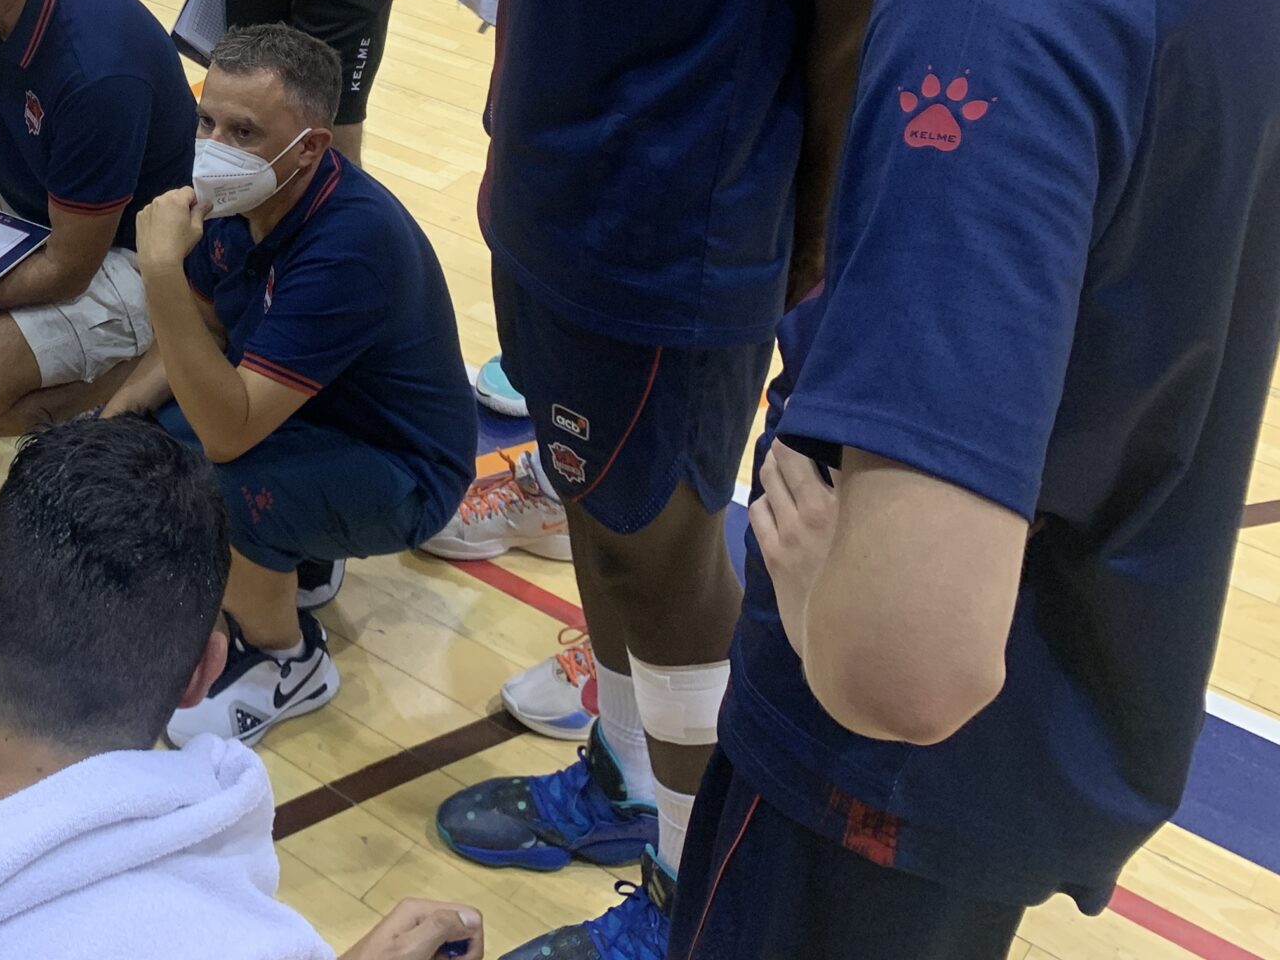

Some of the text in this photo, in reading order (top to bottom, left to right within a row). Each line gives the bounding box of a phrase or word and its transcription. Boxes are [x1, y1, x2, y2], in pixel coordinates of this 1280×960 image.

[351, 37, 371, 91] KELME
[910, 130, 957, 143] KELME
[556, 415, 581, 433] acb
